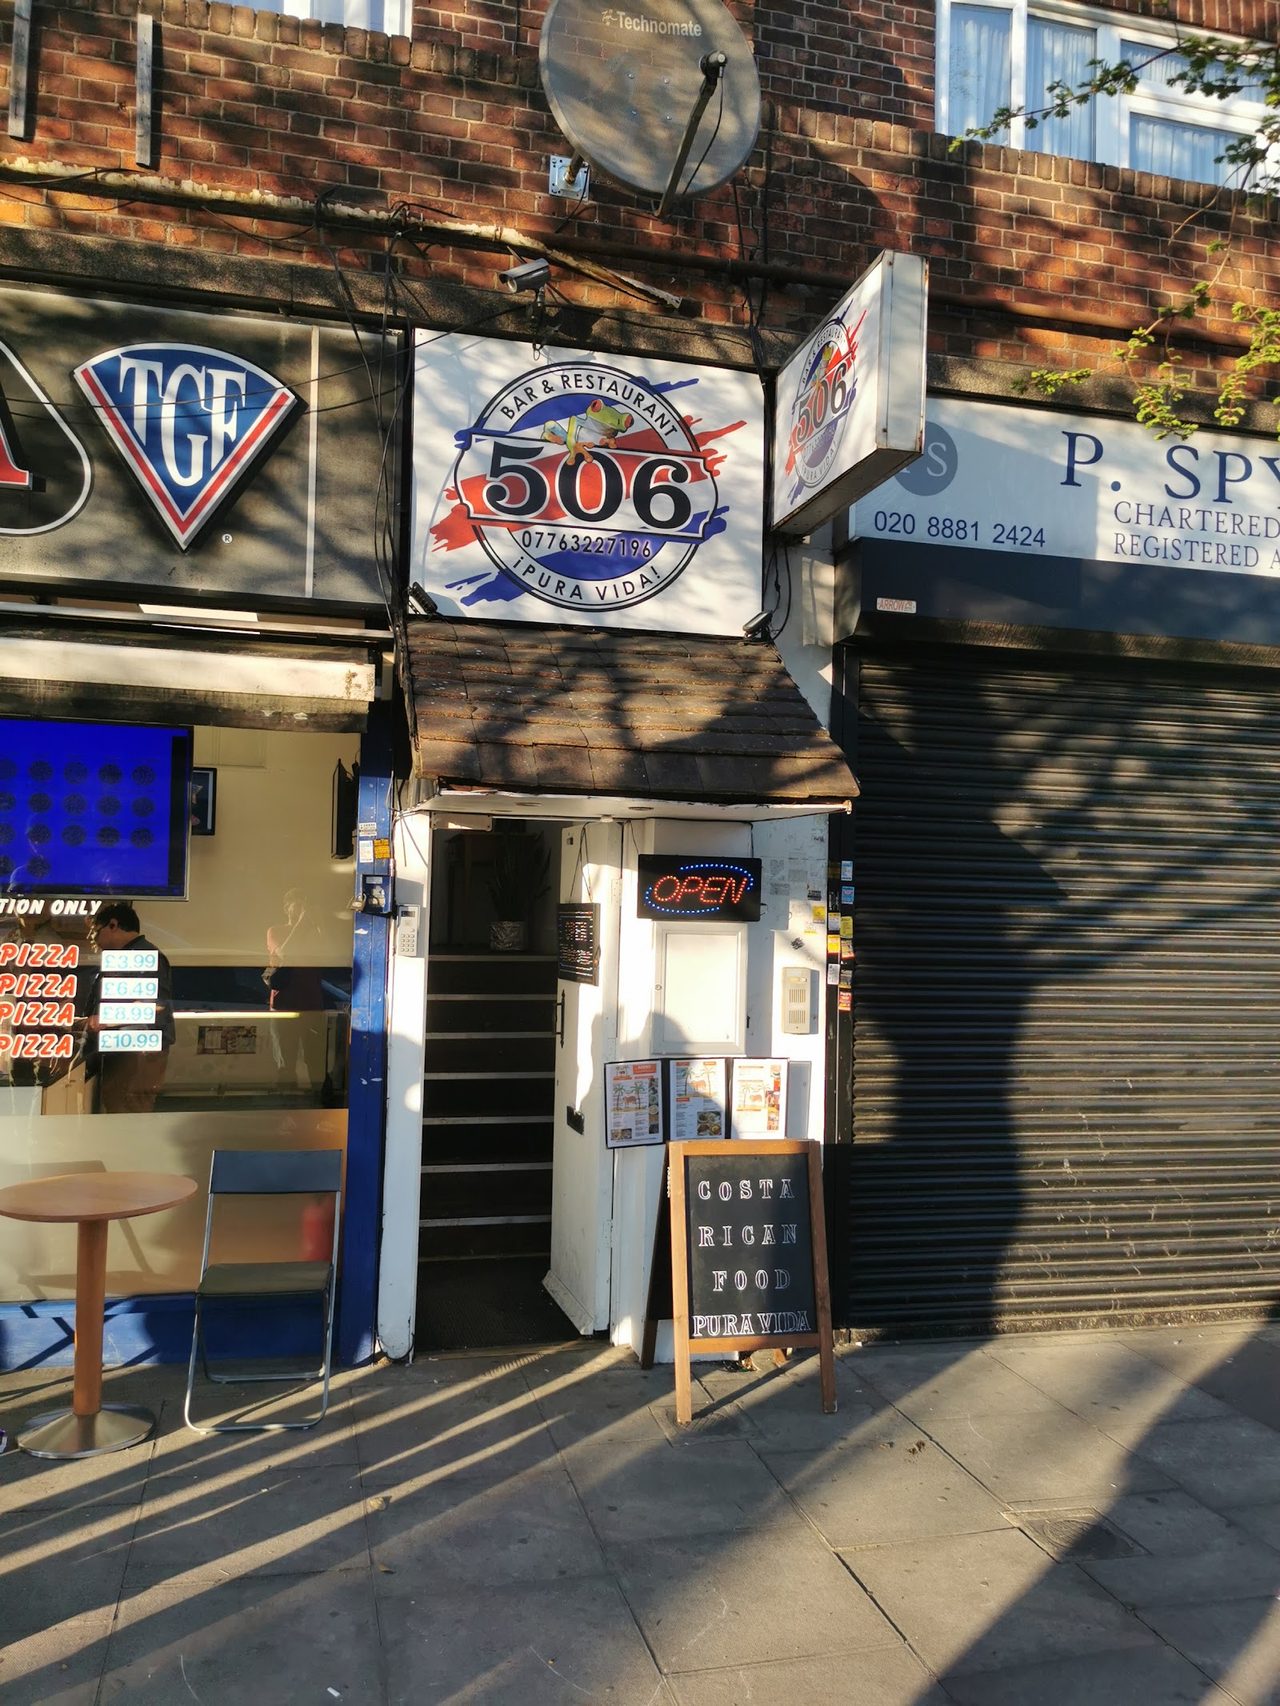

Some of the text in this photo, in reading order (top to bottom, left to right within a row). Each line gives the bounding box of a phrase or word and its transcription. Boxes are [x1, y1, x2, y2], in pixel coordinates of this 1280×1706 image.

[616, 10, 702, 37] Technomate
[501, 373, 678, 438] BAR & RESTAURANT
[798, 362, 847, 443] 506
[119, 354, 247, 487] TGF
[1060, 431, 1121, 491] P.
[485, 441, 692, 530] 506
[874, 510, 1046, 548] 020 8881 2424
[1114, 500, 1280, 539] CHARTERED
[522, 530, 652, 558] 07763227196
[1114, 532, 1259, 567] REGISTERED
[596, 565, 661, 601] VIDA!
[654, 875, 748, 904] OPEN
[51, 899, 102, 916] ONLY
[0, 942, 156, 968] PIZZA £3.99
[0, 973, 156, 998] PIZZA £6.49
[0, 1001, 75, 1026] PIZZA
[100, 1033, 160, 1048] £10.99
[697, 1178, 795, 1201] COSTA
[698, 1223, 797, 1247] RICAN
[712, 1269, 791, 1292] FOOD
[692, 1310, 811, 1338] PURA VIDA
